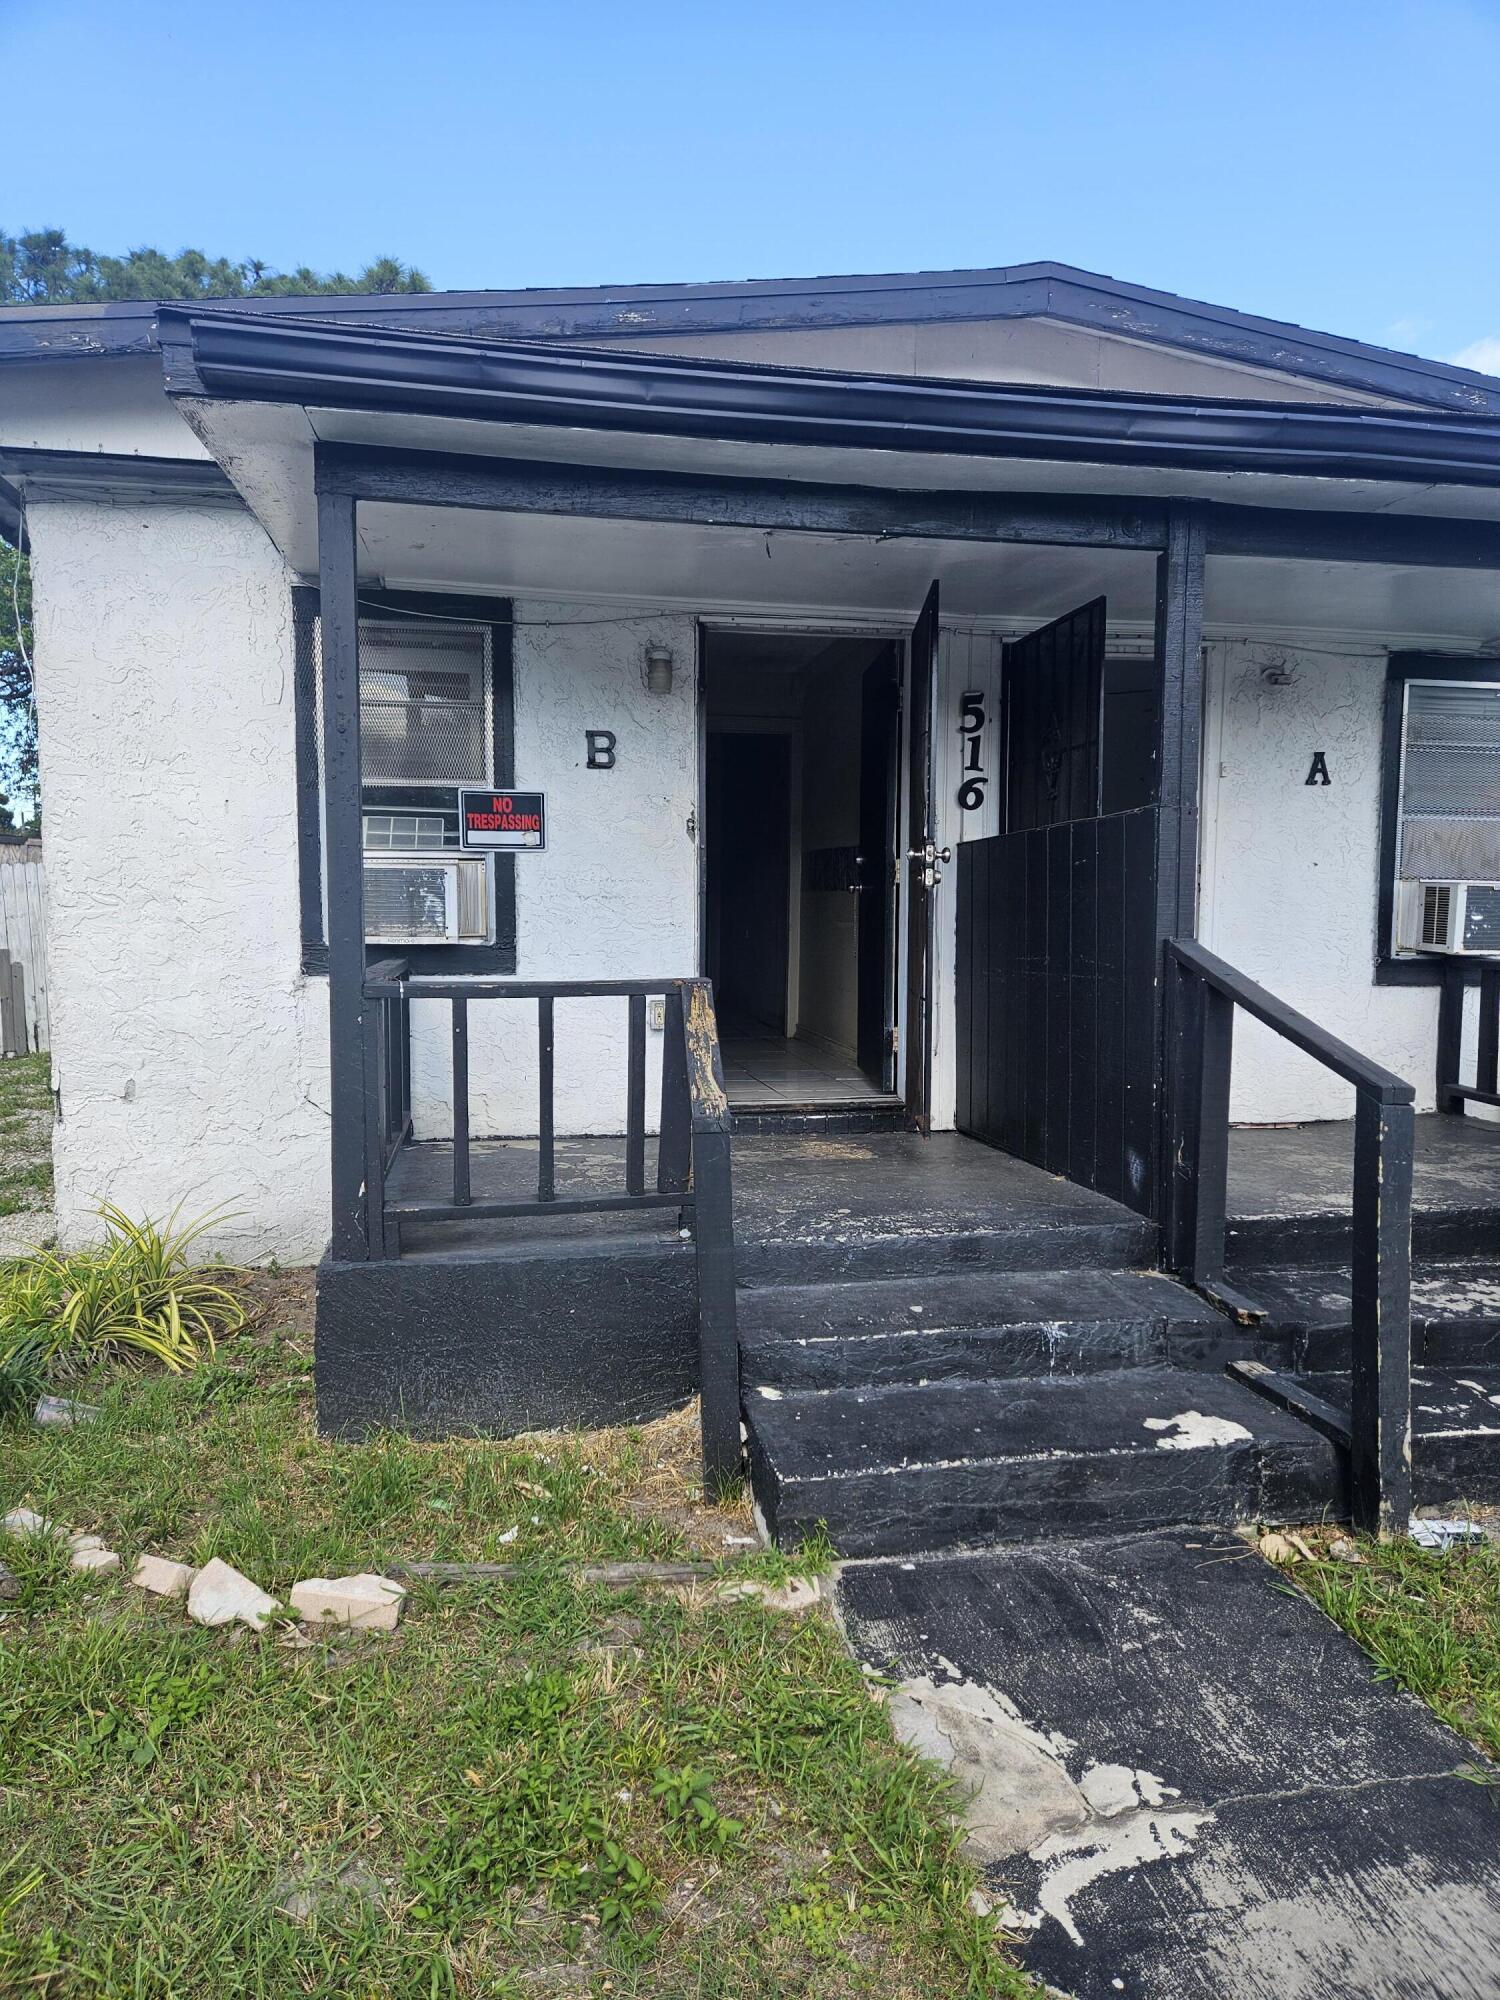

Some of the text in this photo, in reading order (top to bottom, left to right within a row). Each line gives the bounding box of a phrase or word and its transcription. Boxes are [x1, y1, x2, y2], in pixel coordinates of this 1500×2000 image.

[585, 730, 616, 769] B
[959, 692, 988, 811] 516
[1304, 751, 1331, 786] A
[467, 813, 539, 830] TRESPASSING
[492, 797, 512, 813] NO
